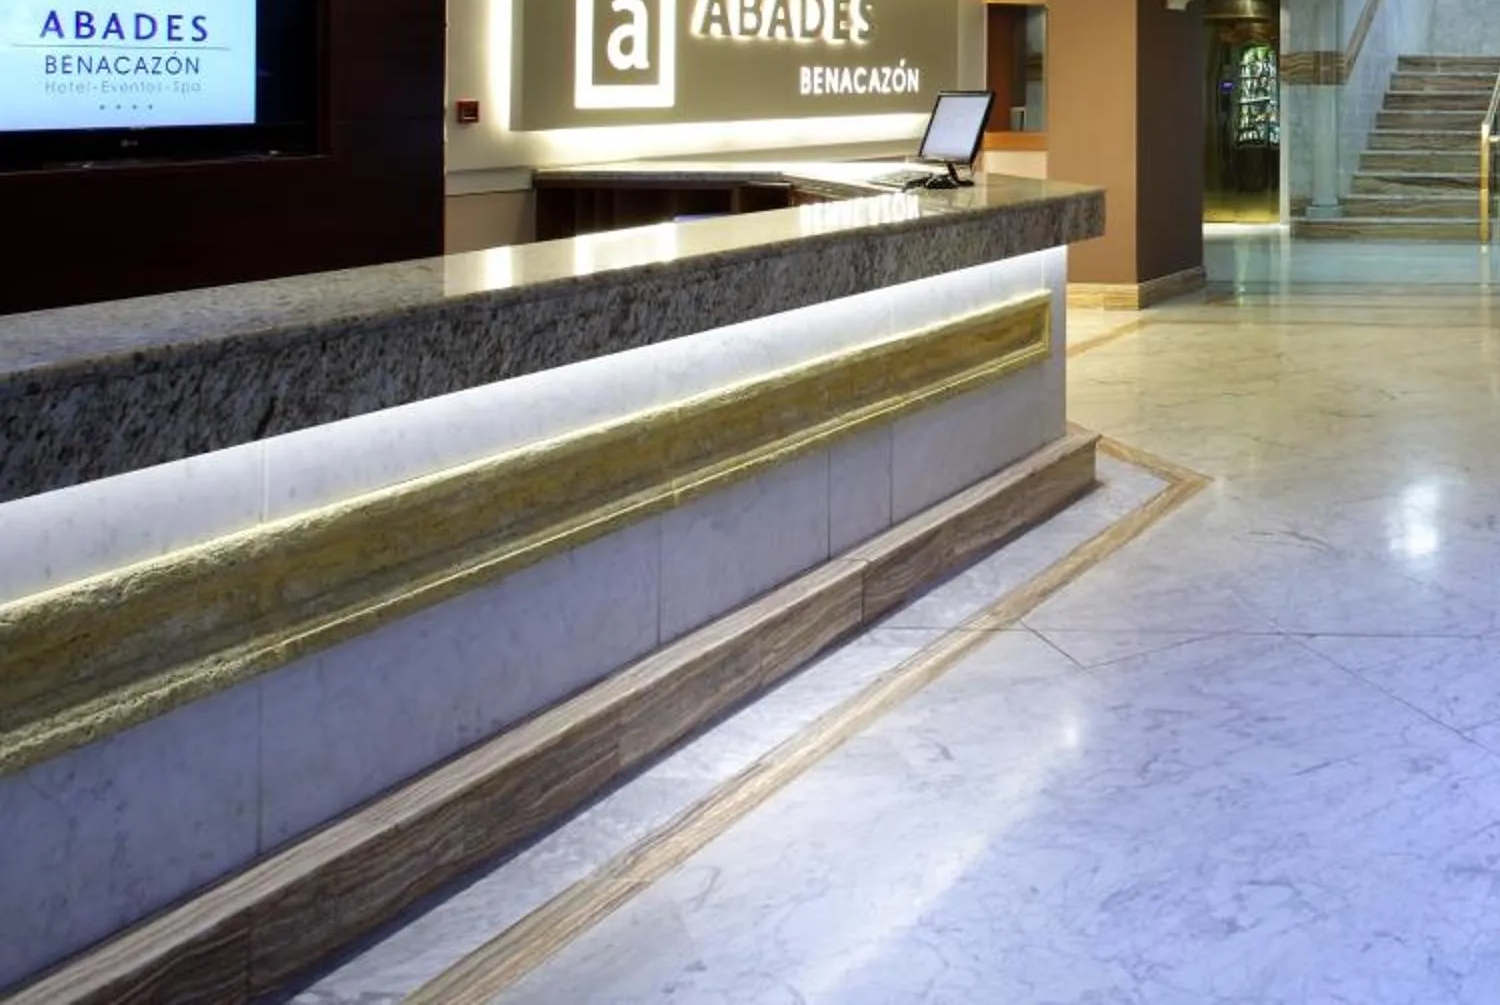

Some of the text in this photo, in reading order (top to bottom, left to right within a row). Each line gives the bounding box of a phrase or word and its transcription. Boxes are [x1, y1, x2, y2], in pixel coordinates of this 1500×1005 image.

[40, 10, 208, 42] ABADES
[44, 52, 200, 75] BENACAZÓN
[800, 59, 919, 94] BENACAZÓN
